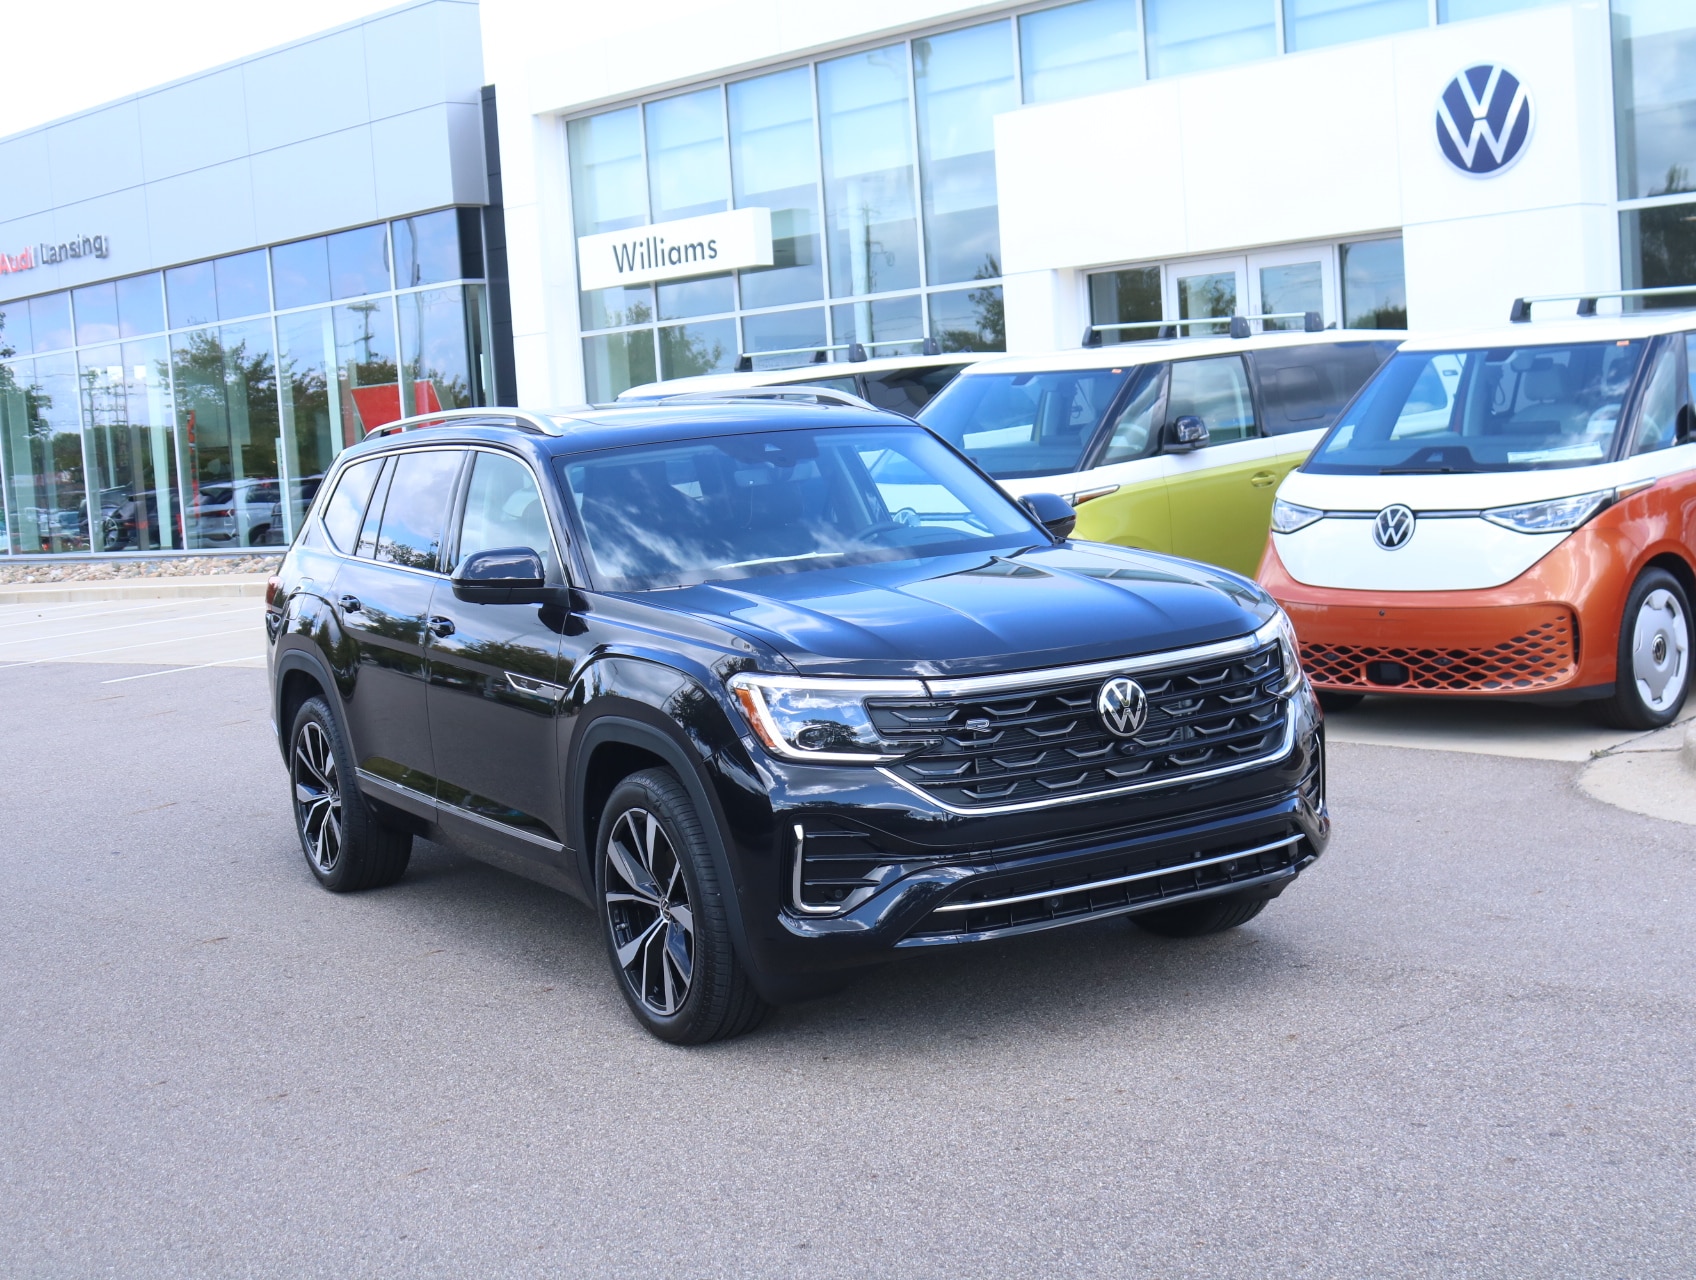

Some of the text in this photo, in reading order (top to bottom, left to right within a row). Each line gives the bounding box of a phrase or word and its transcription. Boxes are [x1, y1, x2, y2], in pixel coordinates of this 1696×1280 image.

[0, 234, 107, 274] Audi Lansing
[612, 236, 718, 273] Williams
